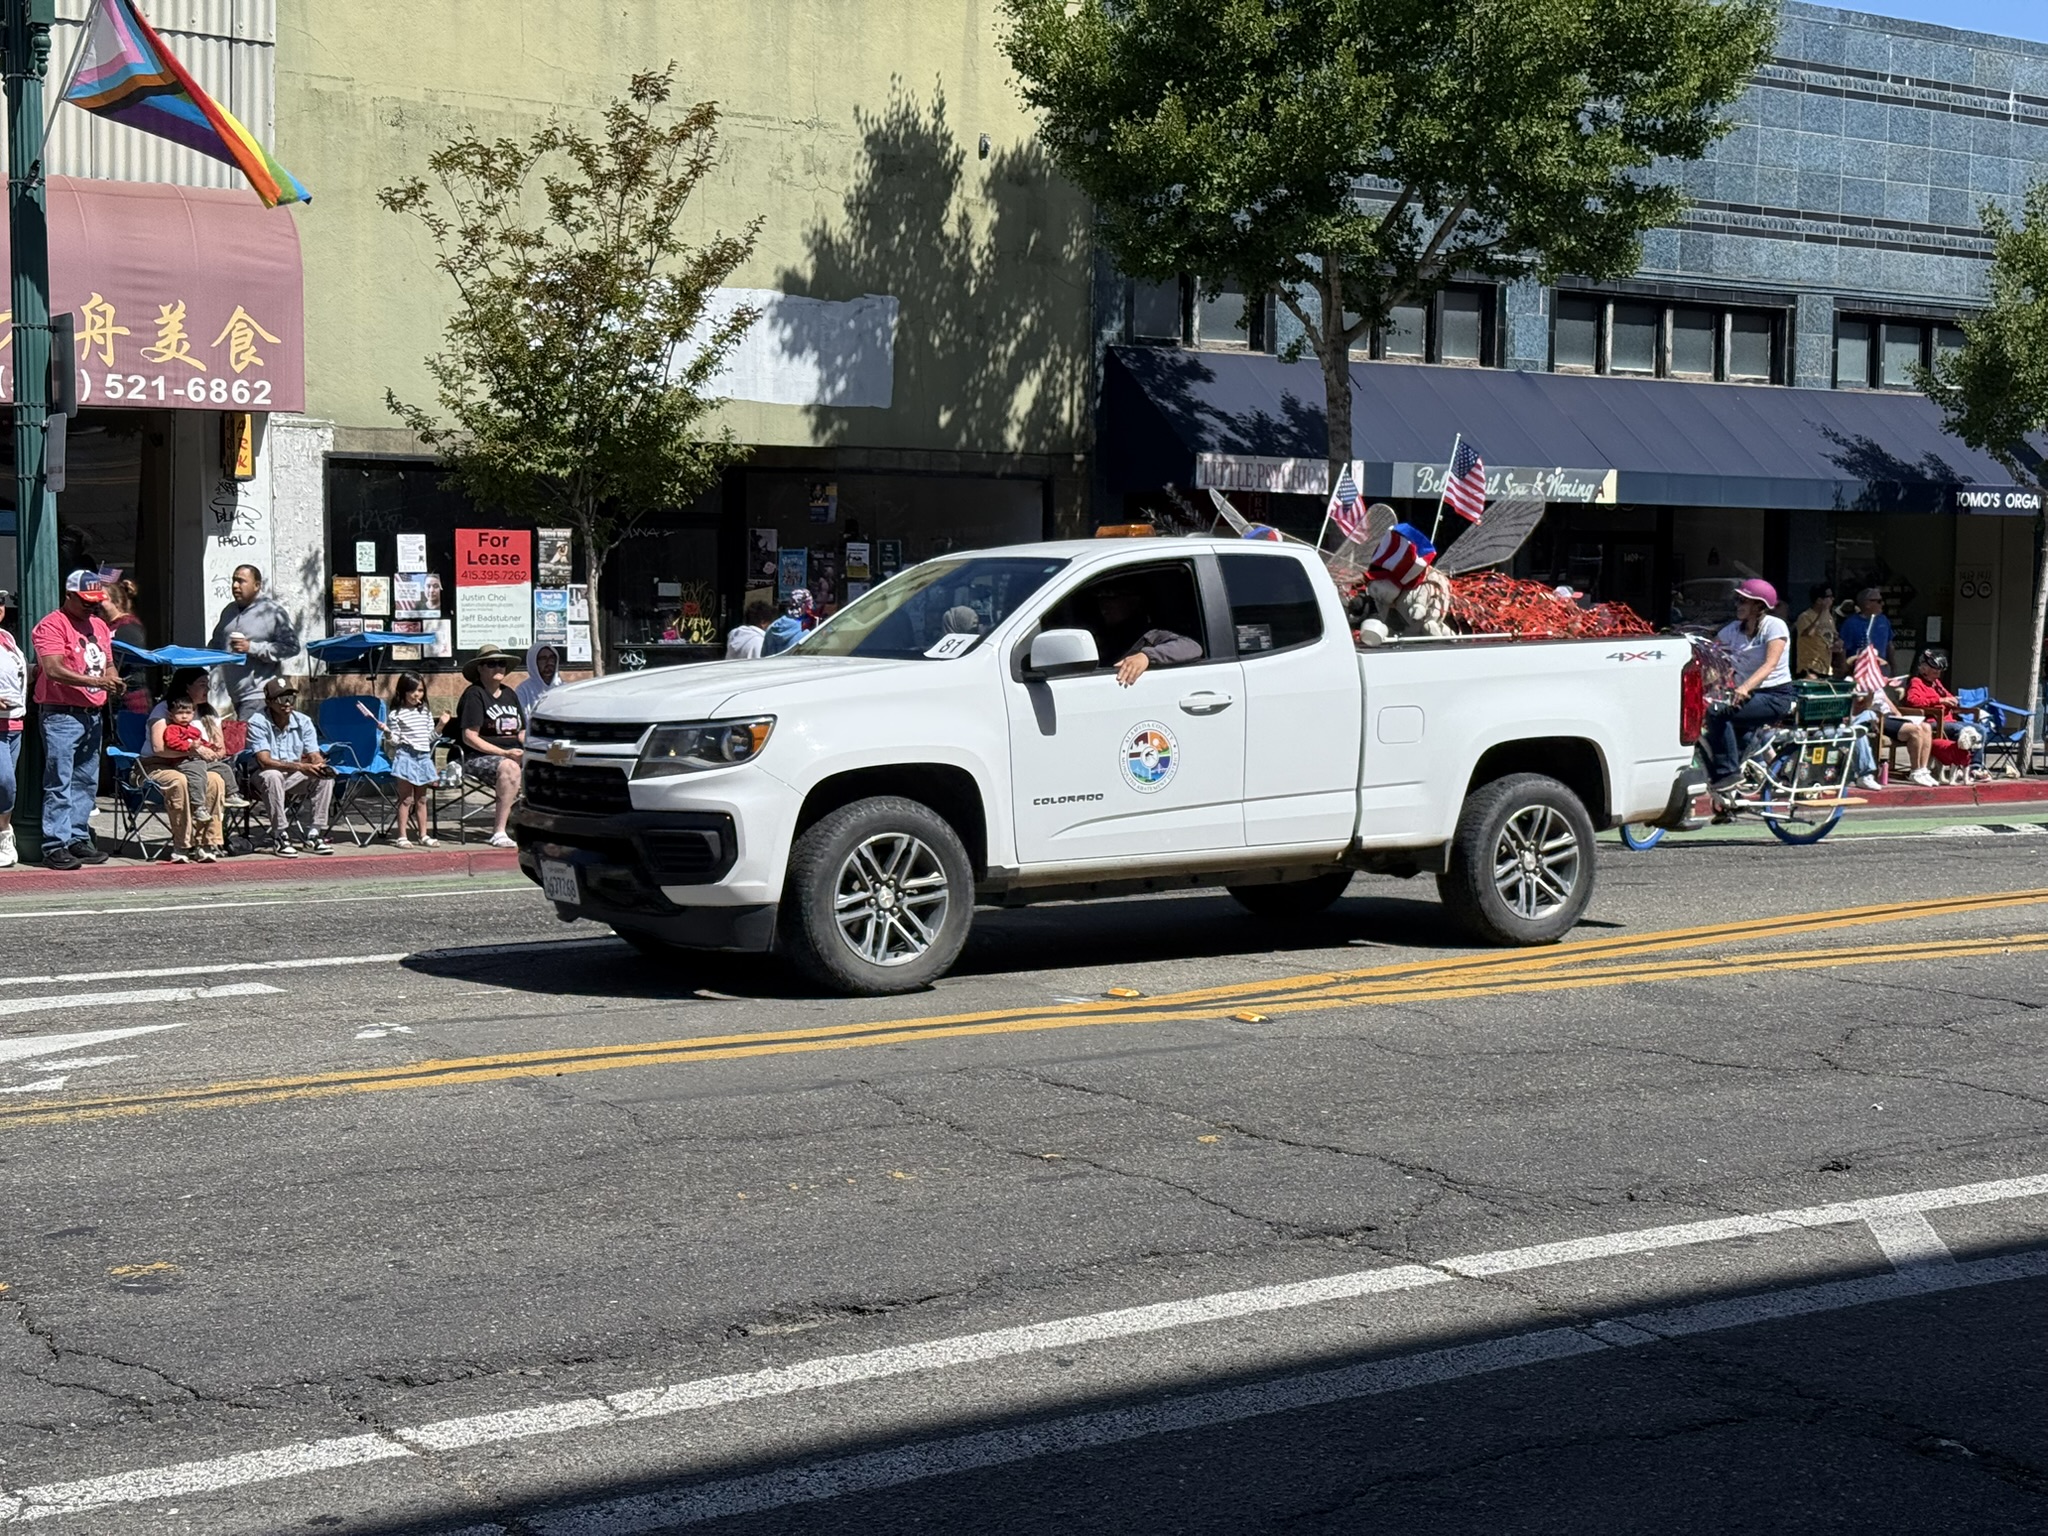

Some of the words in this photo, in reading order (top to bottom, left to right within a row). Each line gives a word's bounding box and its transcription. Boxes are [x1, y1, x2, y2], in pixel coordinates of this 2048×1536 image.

[0, 291, 281, 374] 舟美食
[104, 374, 272, 405] 521-6862
[1204, 460, 1253, 487] LITTLE
[1416, 466, 1448, 494] Bel
[1501, 472, 1528, 499] Spa
[1530, 470, 1545, 495] &
[1545, 472, 1596, 503] Waxing
[1955, 492, 2001, 509] TOMO'S
[2005, 493, 2042, 510] ORGA
[478, 532, 510, 548] For
[467, 550, 521, 566] Lease
[461, 570, 528, 581] 415.395.7262
[460, 593, 486, 602] Justin
[487, 593, 507, 602] Choi
[460, 614, 476, 622] Jeff
[477, 614, 522, 622] Badstubner
[938, 638, 963, 654] 81
[1125, 723, 1151, 743] ALAMEDA
[1151, 722, 1174, 740] COUNTY
[1033, 793, 1104, 806] COLORADO
